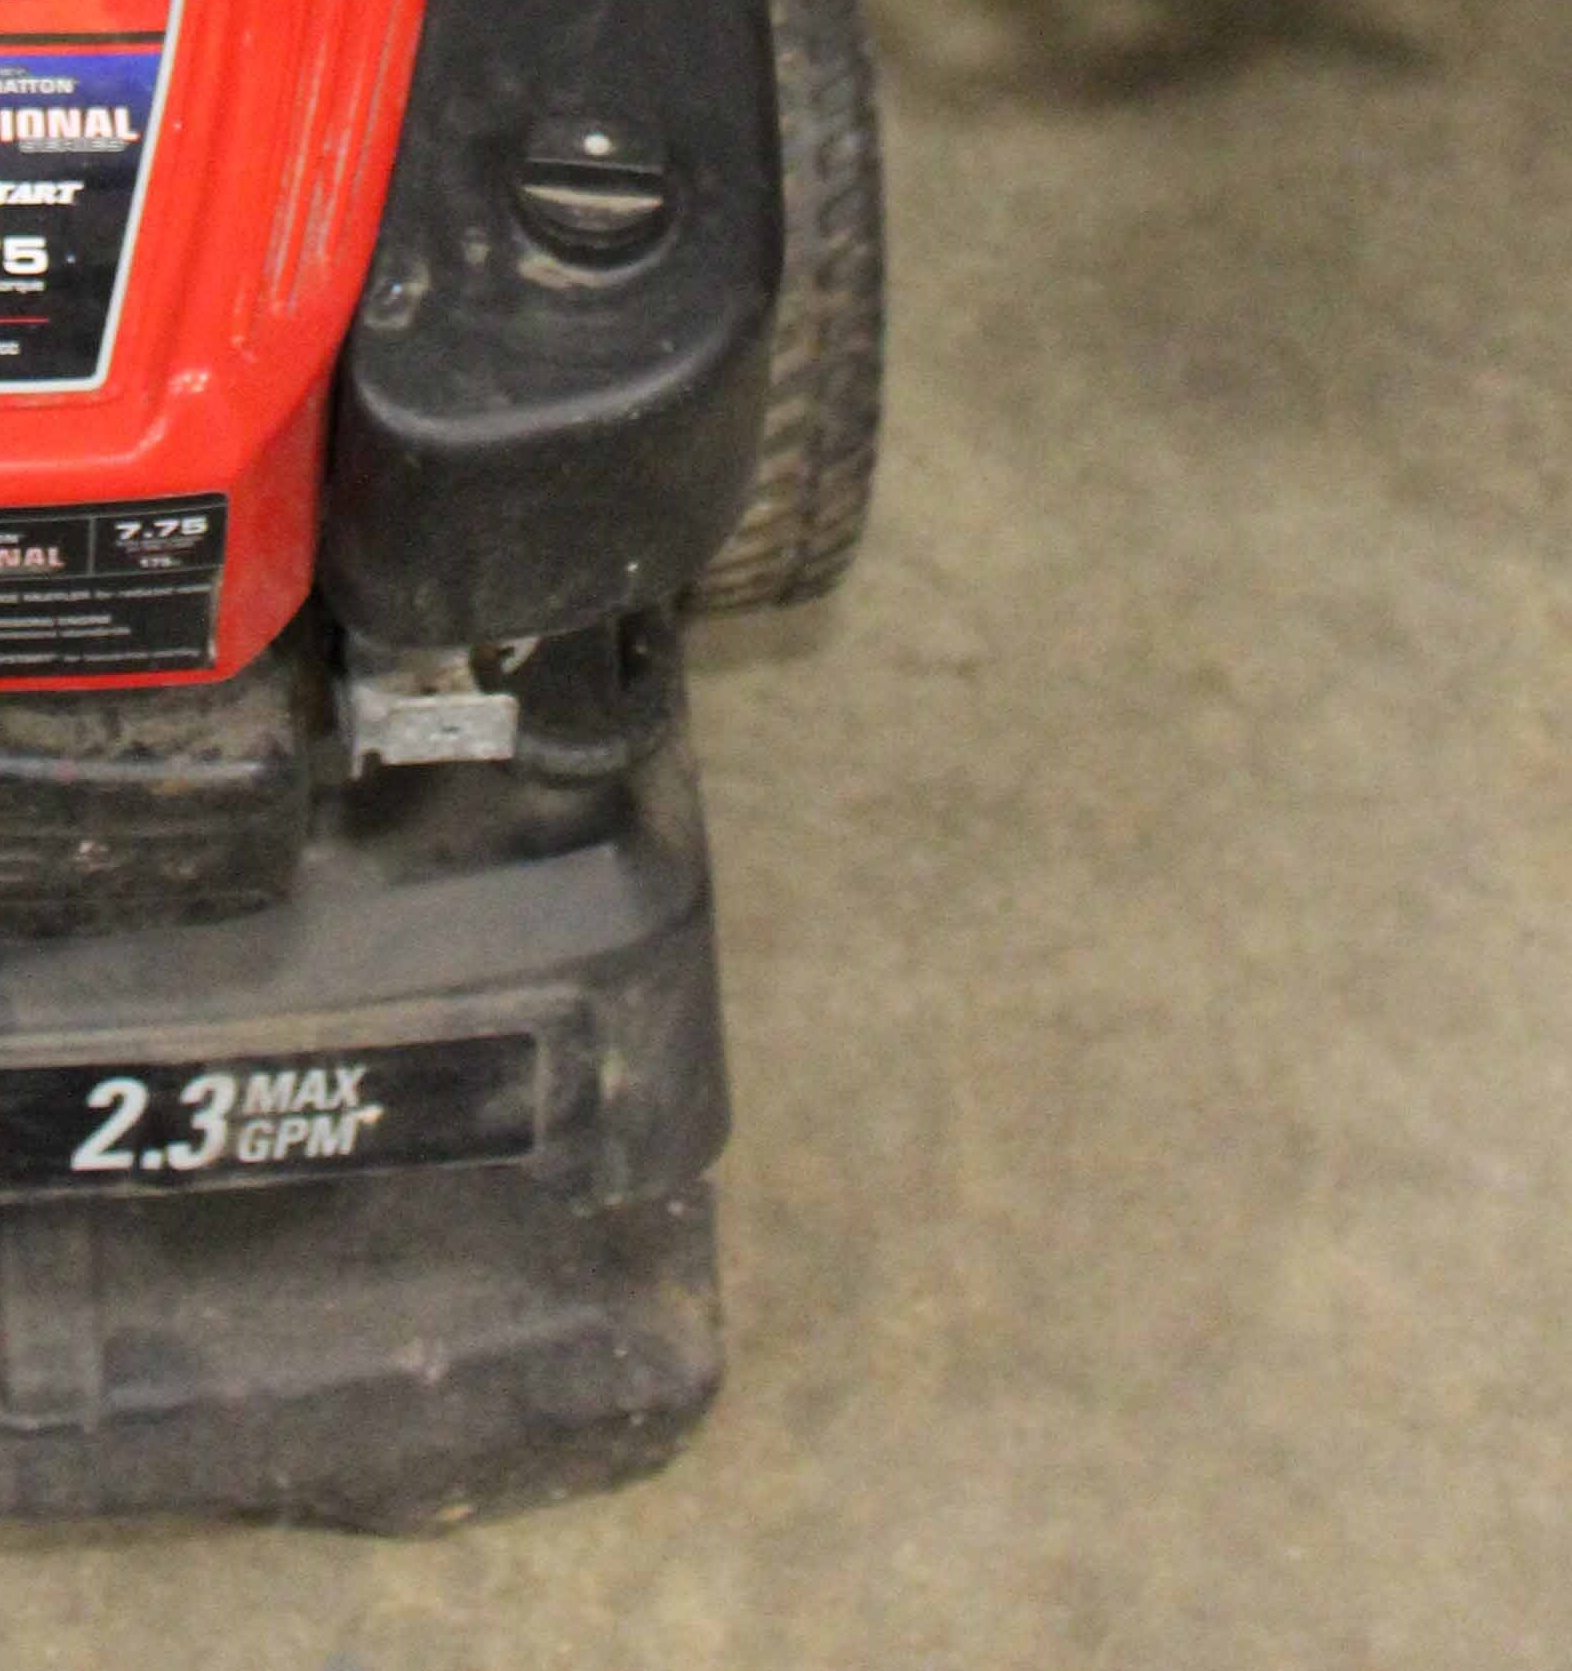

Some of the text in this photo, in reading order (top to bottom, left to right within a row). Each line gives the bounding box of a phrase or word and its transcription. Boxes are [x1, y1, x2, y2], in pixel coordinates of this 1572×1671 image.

[114, 514, 209, 540] 7.75
[71, 1065, 367, 1172] 2.3 MAX
[237, 1110, 358, 1165] GPM
